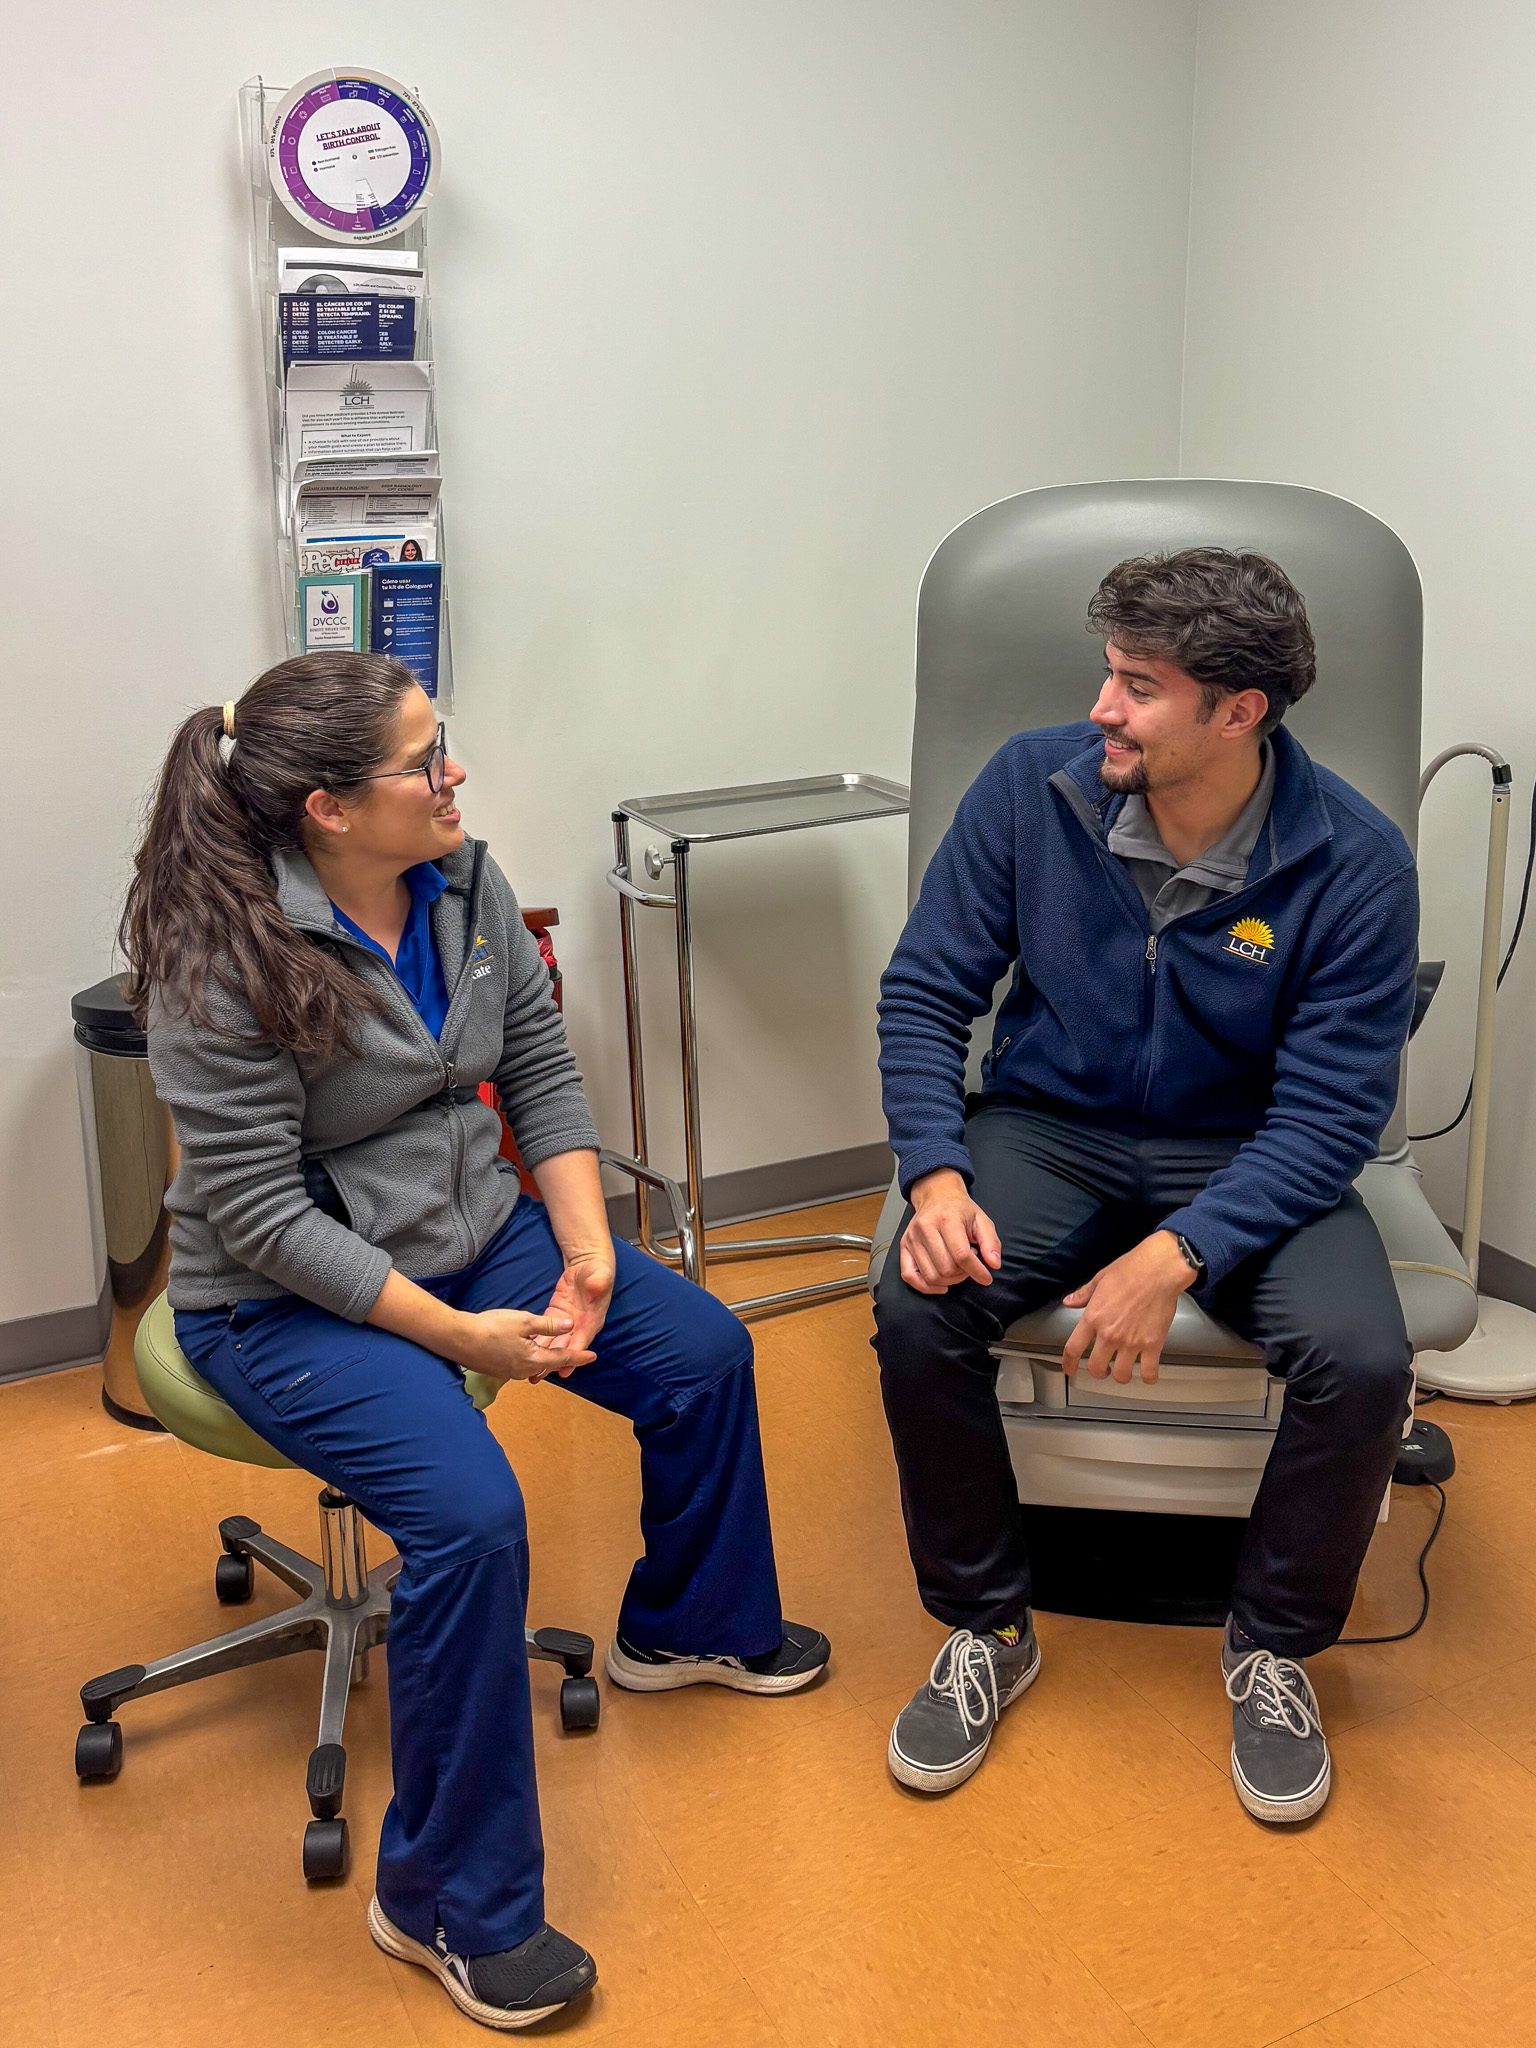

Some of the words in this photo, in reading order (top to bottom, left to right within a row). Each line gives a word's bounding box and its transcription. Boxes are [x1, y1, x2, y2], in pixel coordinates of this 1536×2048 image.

[272, 116, 282, 135] effective
[419, 109, 431, 128] effective
[316, 131, 336, 142] LET'S
[336, 127, 356, 137] TALK
[356, 122, 381, 134] ABOUT
[322, 140, 345, 150] BIRTH
[345, 133, 381, 146] CONTROL
[344, 396, 370, 406] LCH
[304, 548, 366, 574] Peopl
[313, 616, 347, 626] DVCCC
[1228, 938, 1266, 960] LCH
